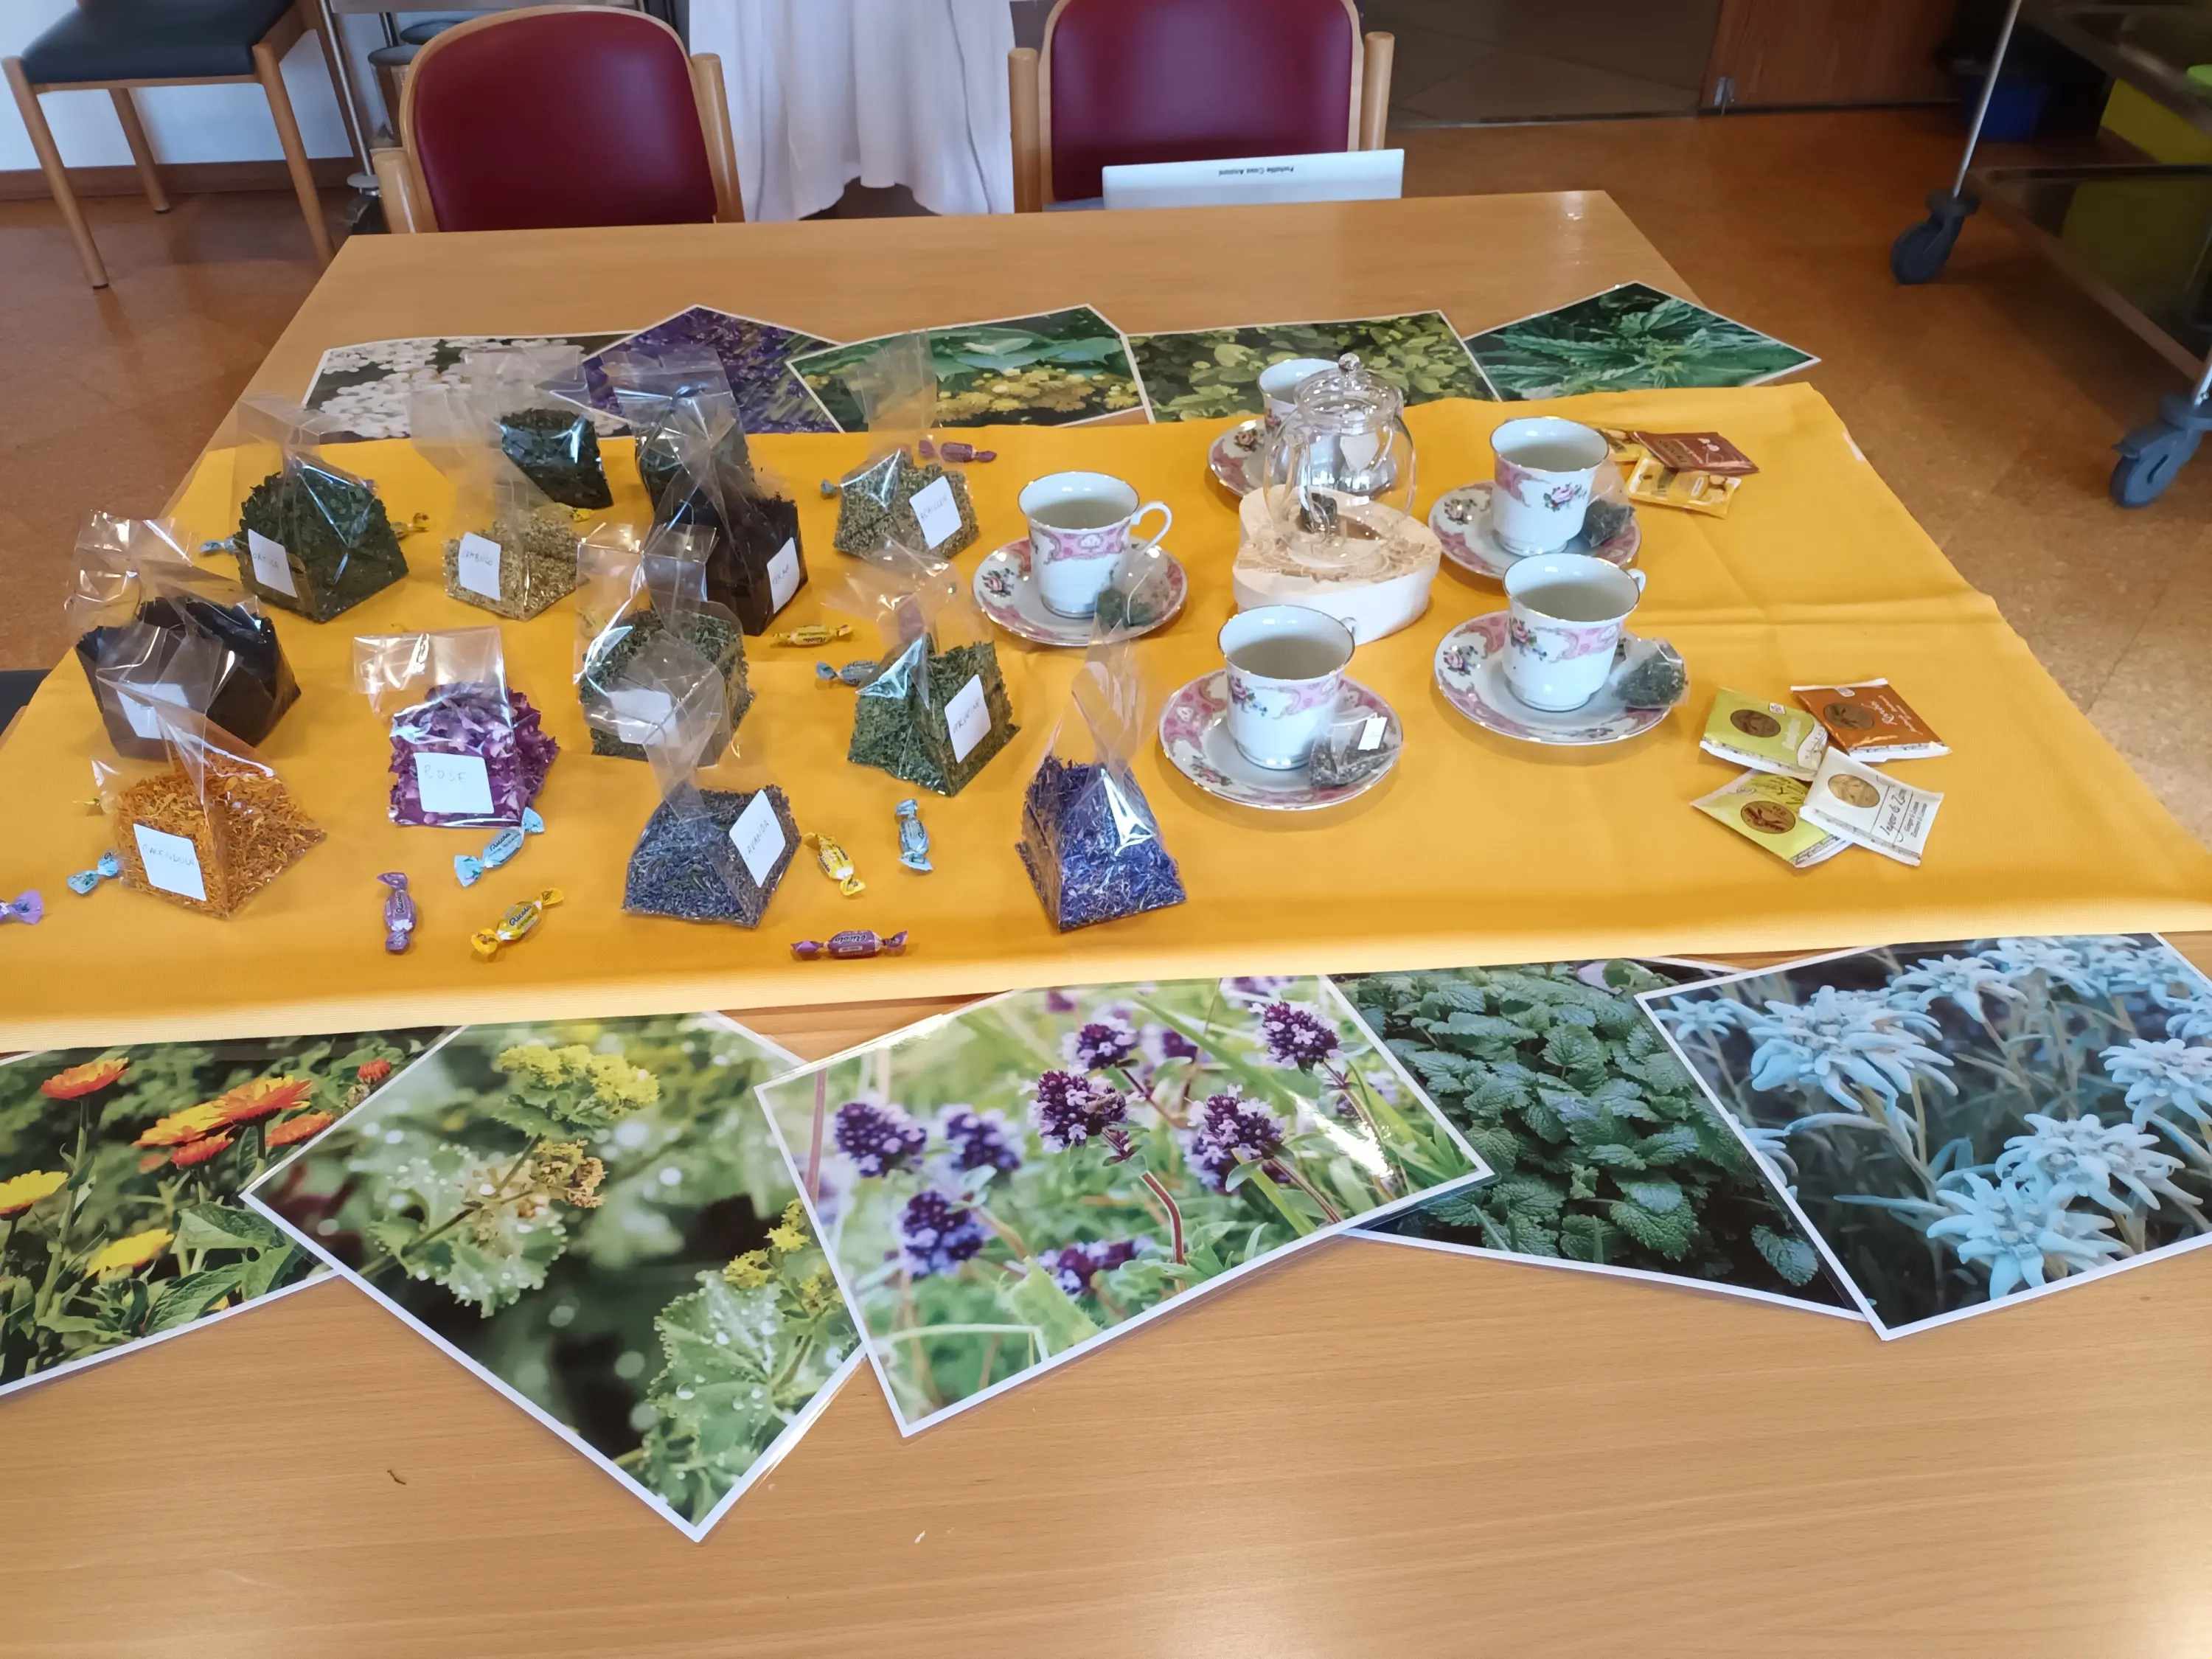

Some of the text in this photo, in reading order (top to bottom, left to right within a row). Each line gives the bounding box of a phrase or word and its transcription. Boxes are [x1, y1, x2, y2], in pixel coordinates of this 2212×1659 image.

[422, 764, 467, 783] ROSE
[489, 832, 512, 852] Ricola
[745, 819, 770, 861] LAVANDA
[396, 891, 405, 914] Ricola
[509, 905, 532, 927] Ricola
[832, 934, 867, 945] Ricola
